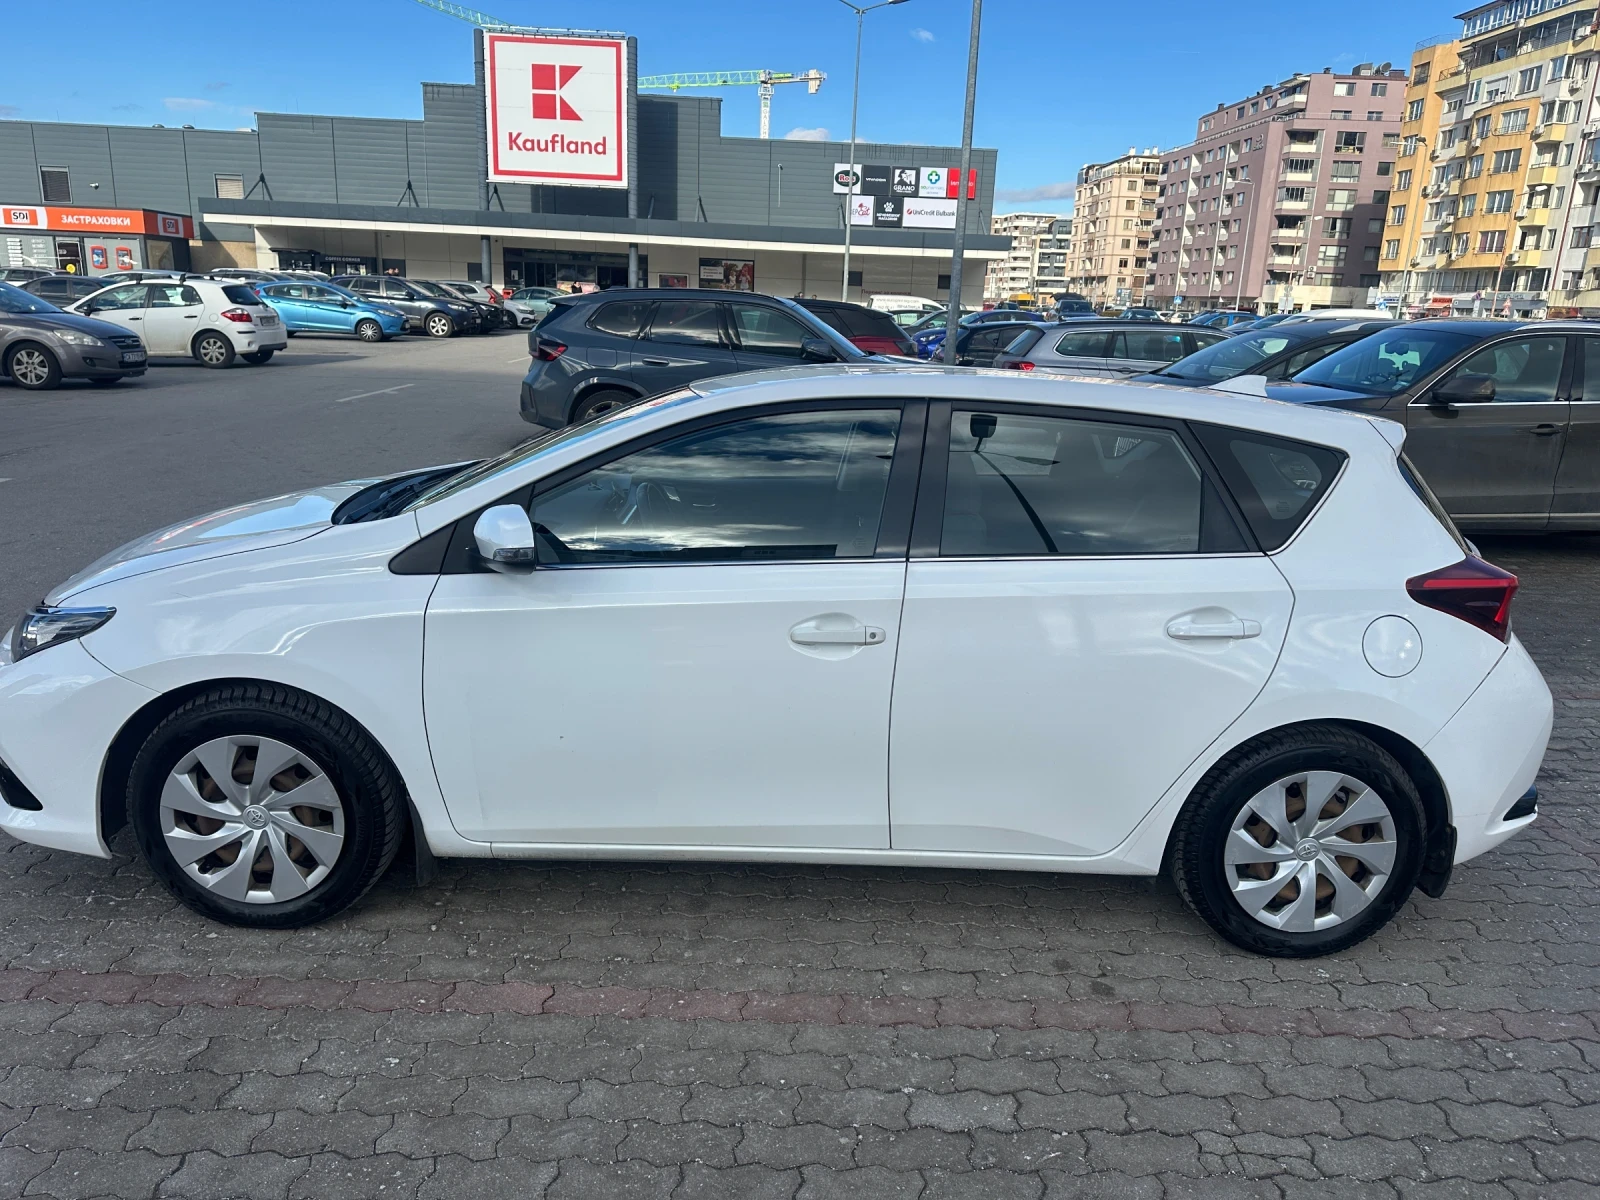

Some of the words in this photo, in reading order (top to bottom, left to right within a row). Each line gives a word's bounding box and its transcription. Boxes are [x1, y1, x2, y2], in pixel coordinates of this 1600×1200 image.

[531, 63, 584, 122] K
[508, 131, 607, 155] Kaufland
[893, 184, 915, 192] GRANO
[12, 212, 28, 220] SDI
[61, 214, 131, 226] ЗАСТРАХОВКИ
